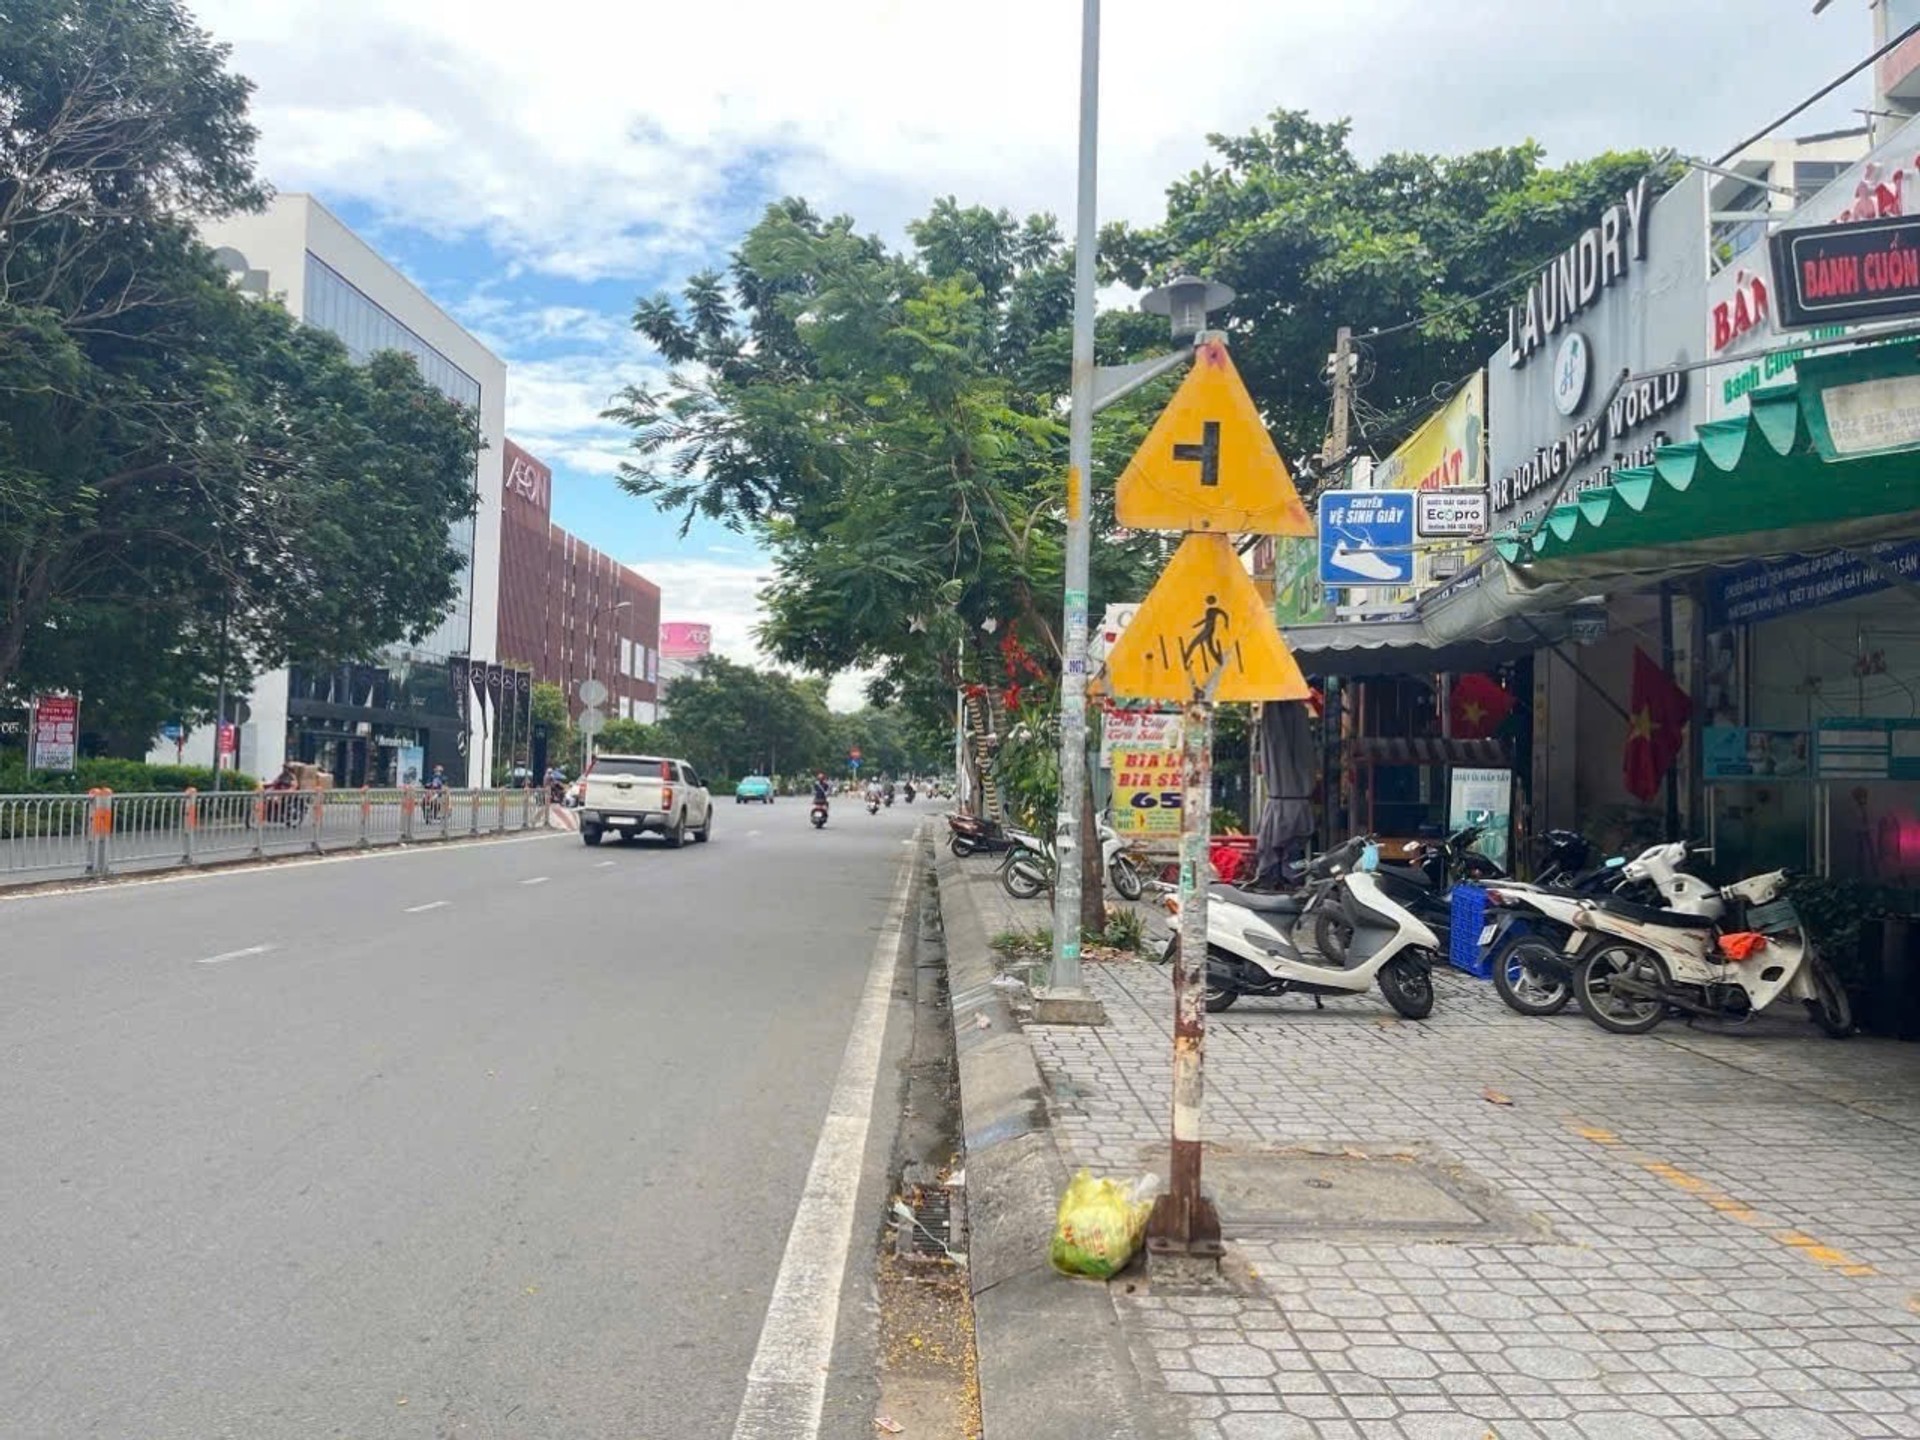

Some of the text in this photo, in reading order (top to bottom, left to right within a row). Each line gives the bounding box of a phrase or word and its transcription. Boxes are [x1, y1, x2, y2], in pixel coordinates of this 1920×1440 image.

[1508, 176, 1649, 369] LAUNDRY
[1804, 232, 1919, 298] BÁNH CUỐN
[1492, 478, 1509, 512] MR
[1608, 371, 1680, 438] WORLD
[1345, 509, 1373, 524] SINH
[1427, 508, 1480, 522] Ecopro
